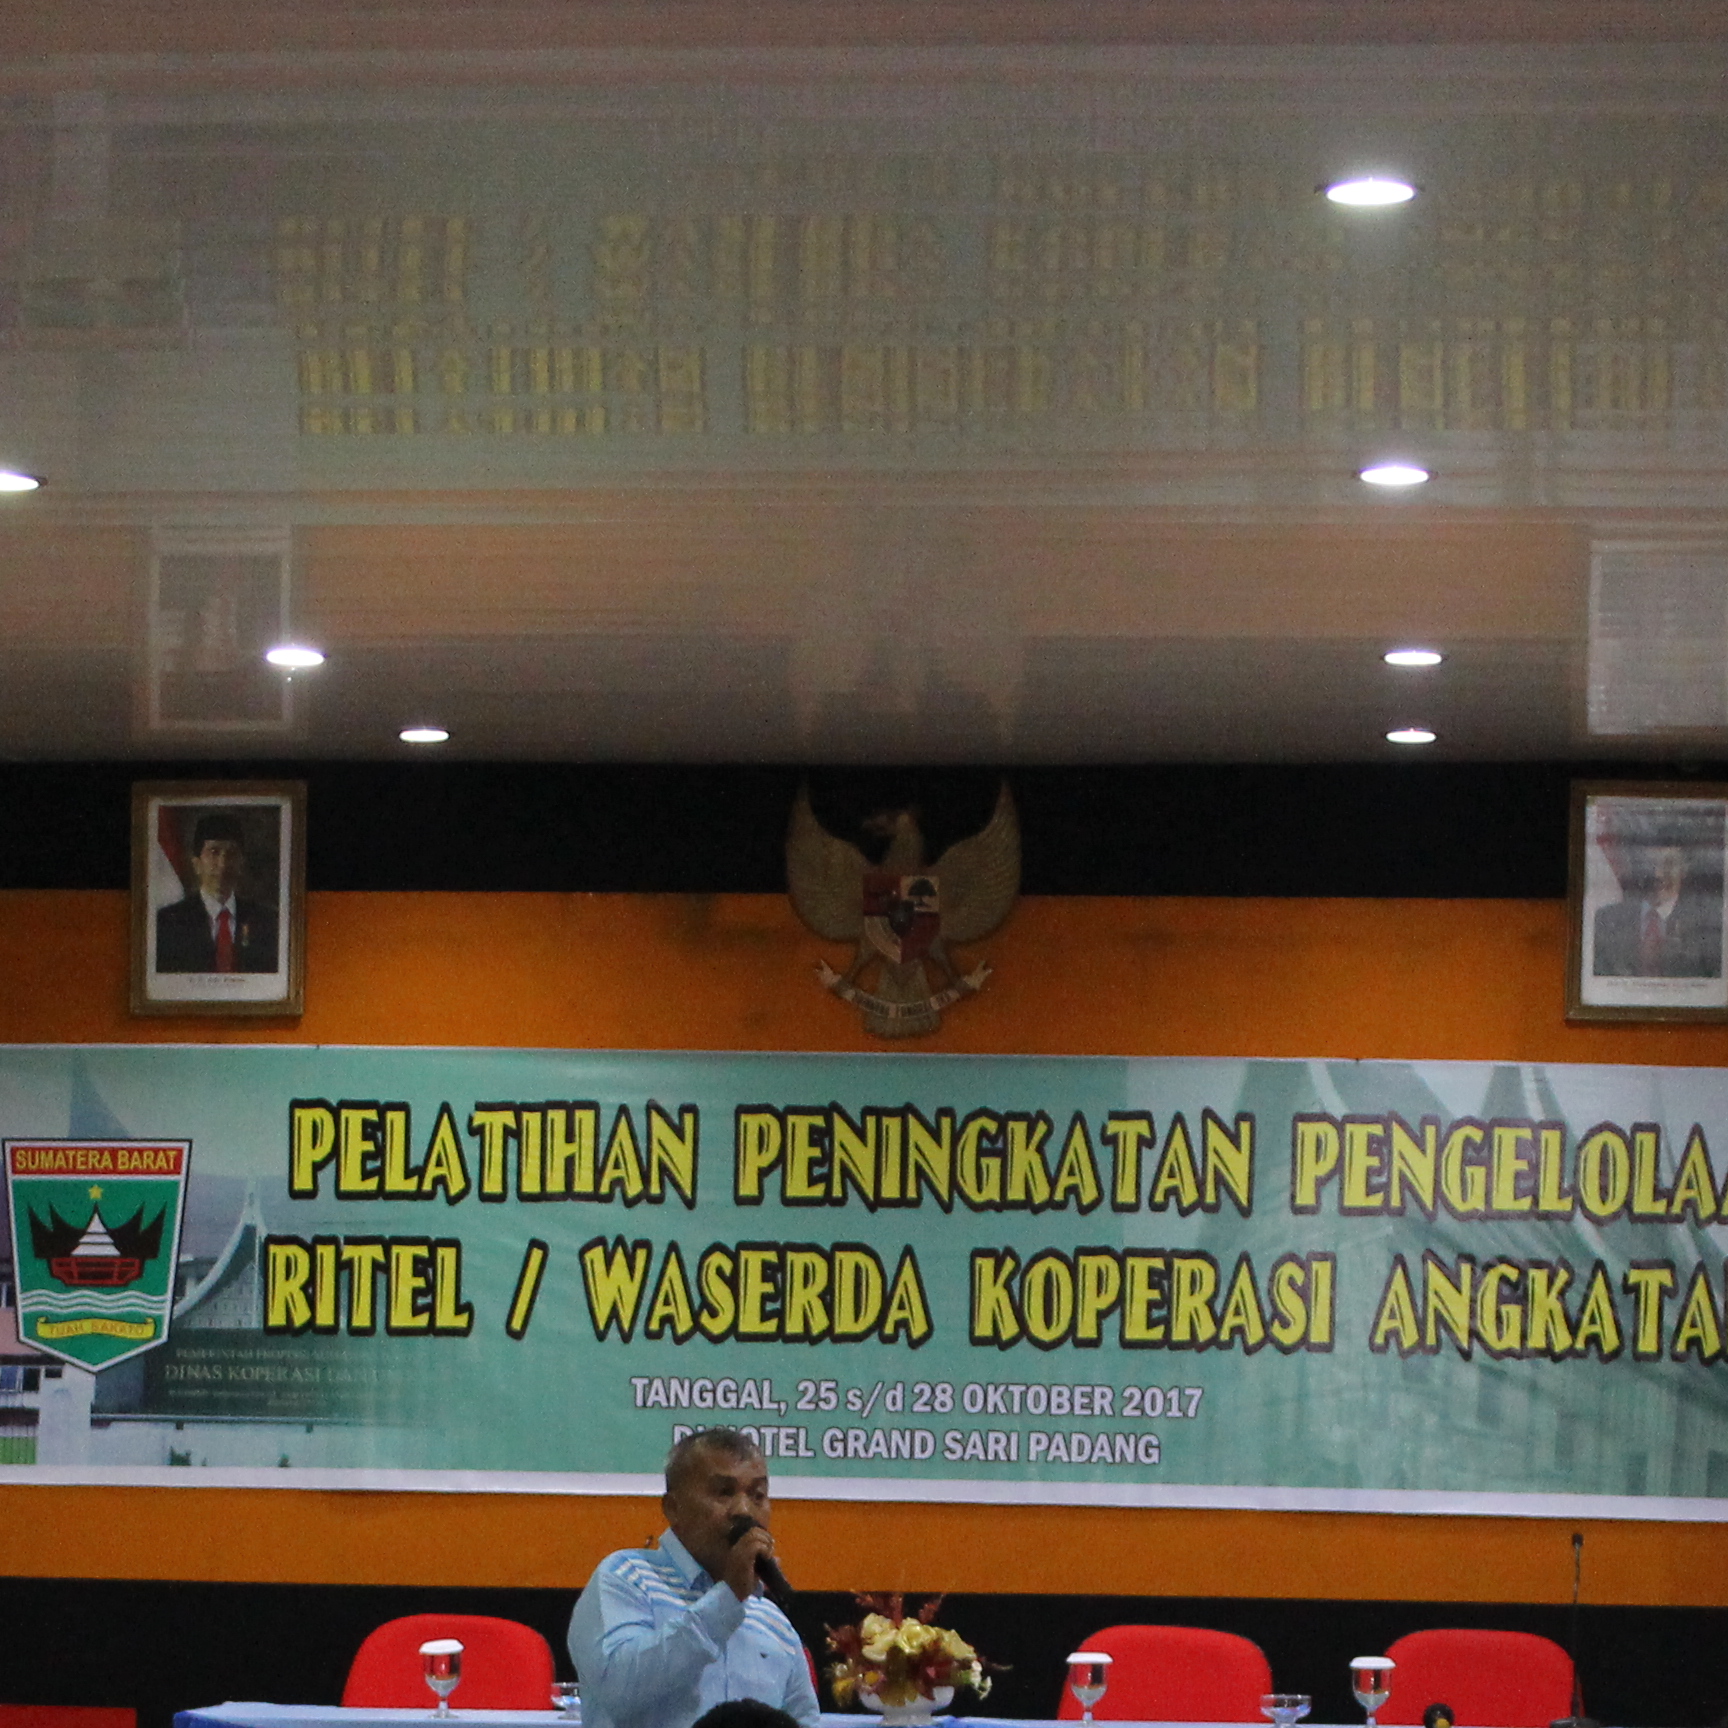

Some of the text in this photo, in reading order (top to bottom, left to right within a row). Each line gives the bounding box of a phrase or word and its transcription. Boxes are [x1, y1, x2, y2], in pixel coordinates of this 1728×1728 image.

[15, 1150, 178, 1170] SUMATERA BARAT
[288, 1098, 698, 1209] PELATIHAN
[734, 1100, 1256, 1218] PENINGKATAN
[263, 1233, 473, 1336] RITEL
[579, 1233, 935, 1348] WASERDA
[968, 1246, 1336, 1355] KOPERASI
[164, 1364, 223, 1381] DINAS
[630, 1376, 1204, 1419] TANGGAL, 25 s/d 28 OKTOBER 2017
[719, 1425, 816, 1458] OTEL
[822, 1427, 936, 1462] GRAND
[942, 1429, 1020, 1463] SARI
[1027, 1431, 1161, 1465] PADANG
